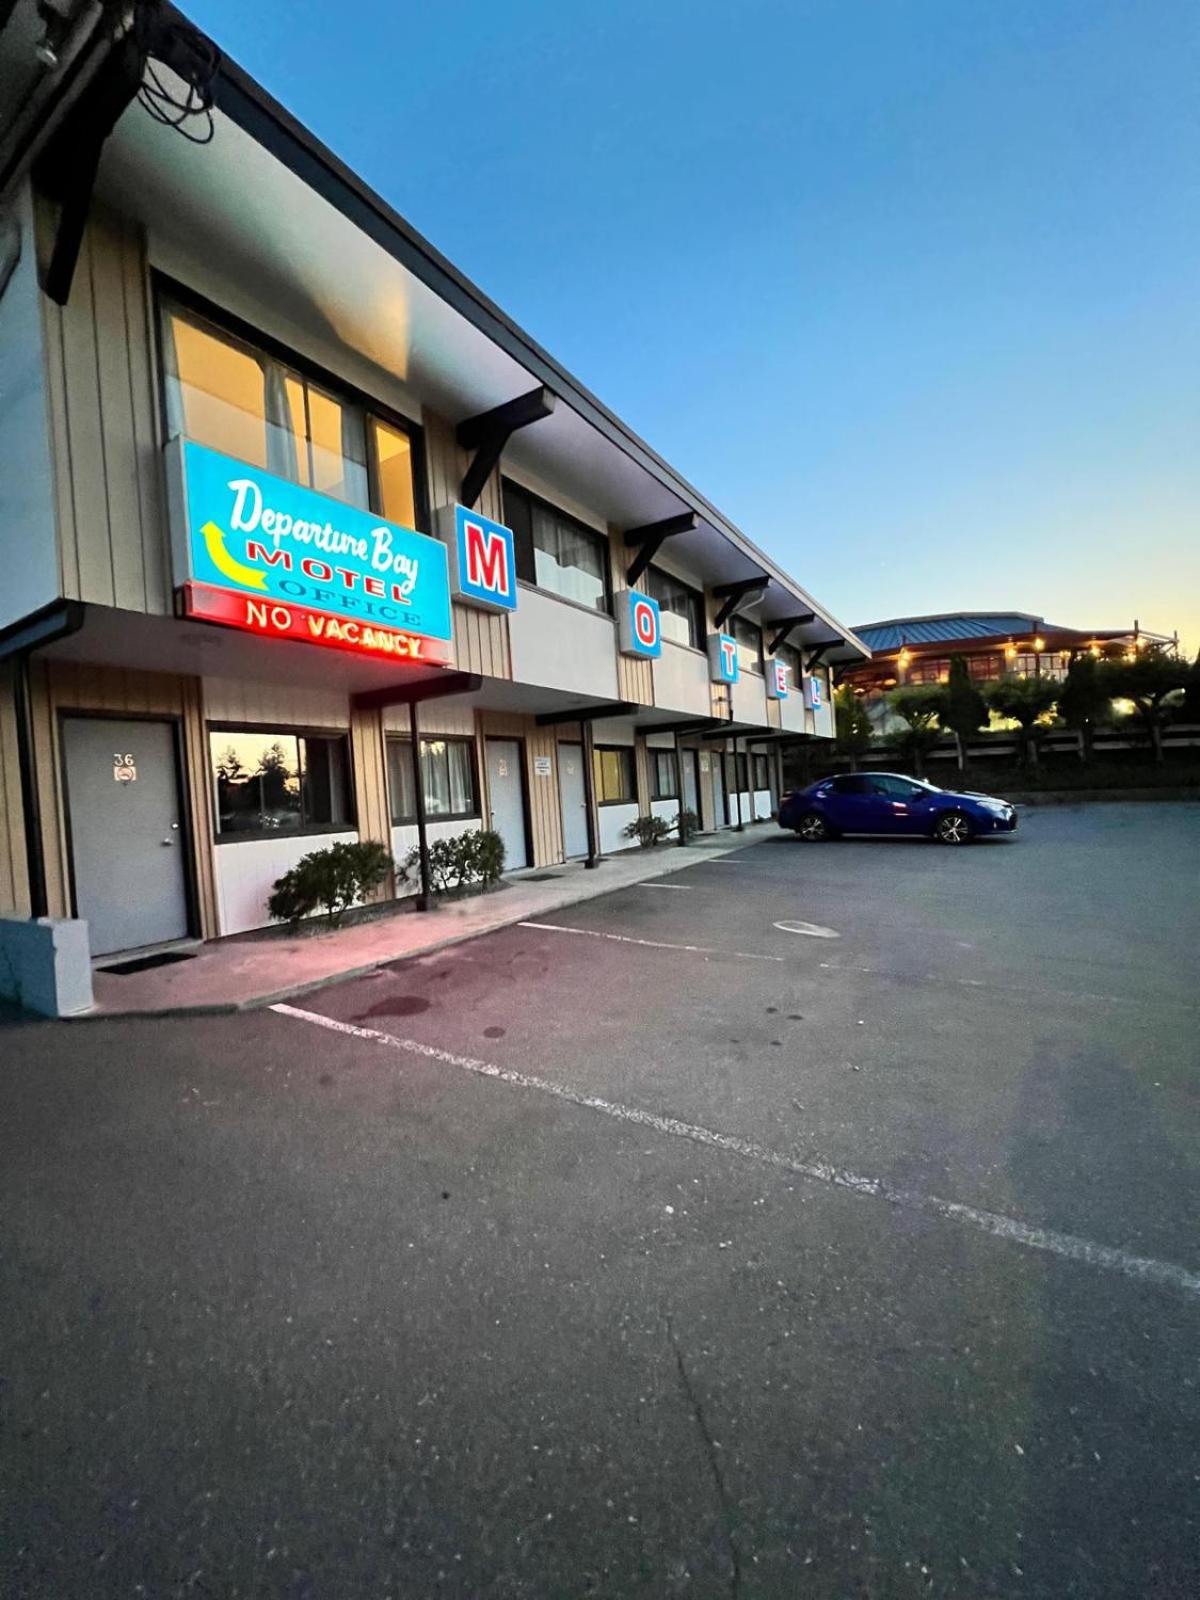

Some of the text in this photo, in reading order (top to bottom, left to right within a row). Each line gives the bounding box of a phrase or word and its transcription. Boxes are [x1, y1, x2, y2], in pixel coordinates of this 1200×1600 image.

[227, 479, 418, 595] Departure Bay
[463, 518, 510, 598] M
[246, 539, 412, 606] MOTEL
[278, 579, 424, 627] OFFICE
[245, 600, 424, 660] NO VACANCY
[113, 753, 135, 767] 36
